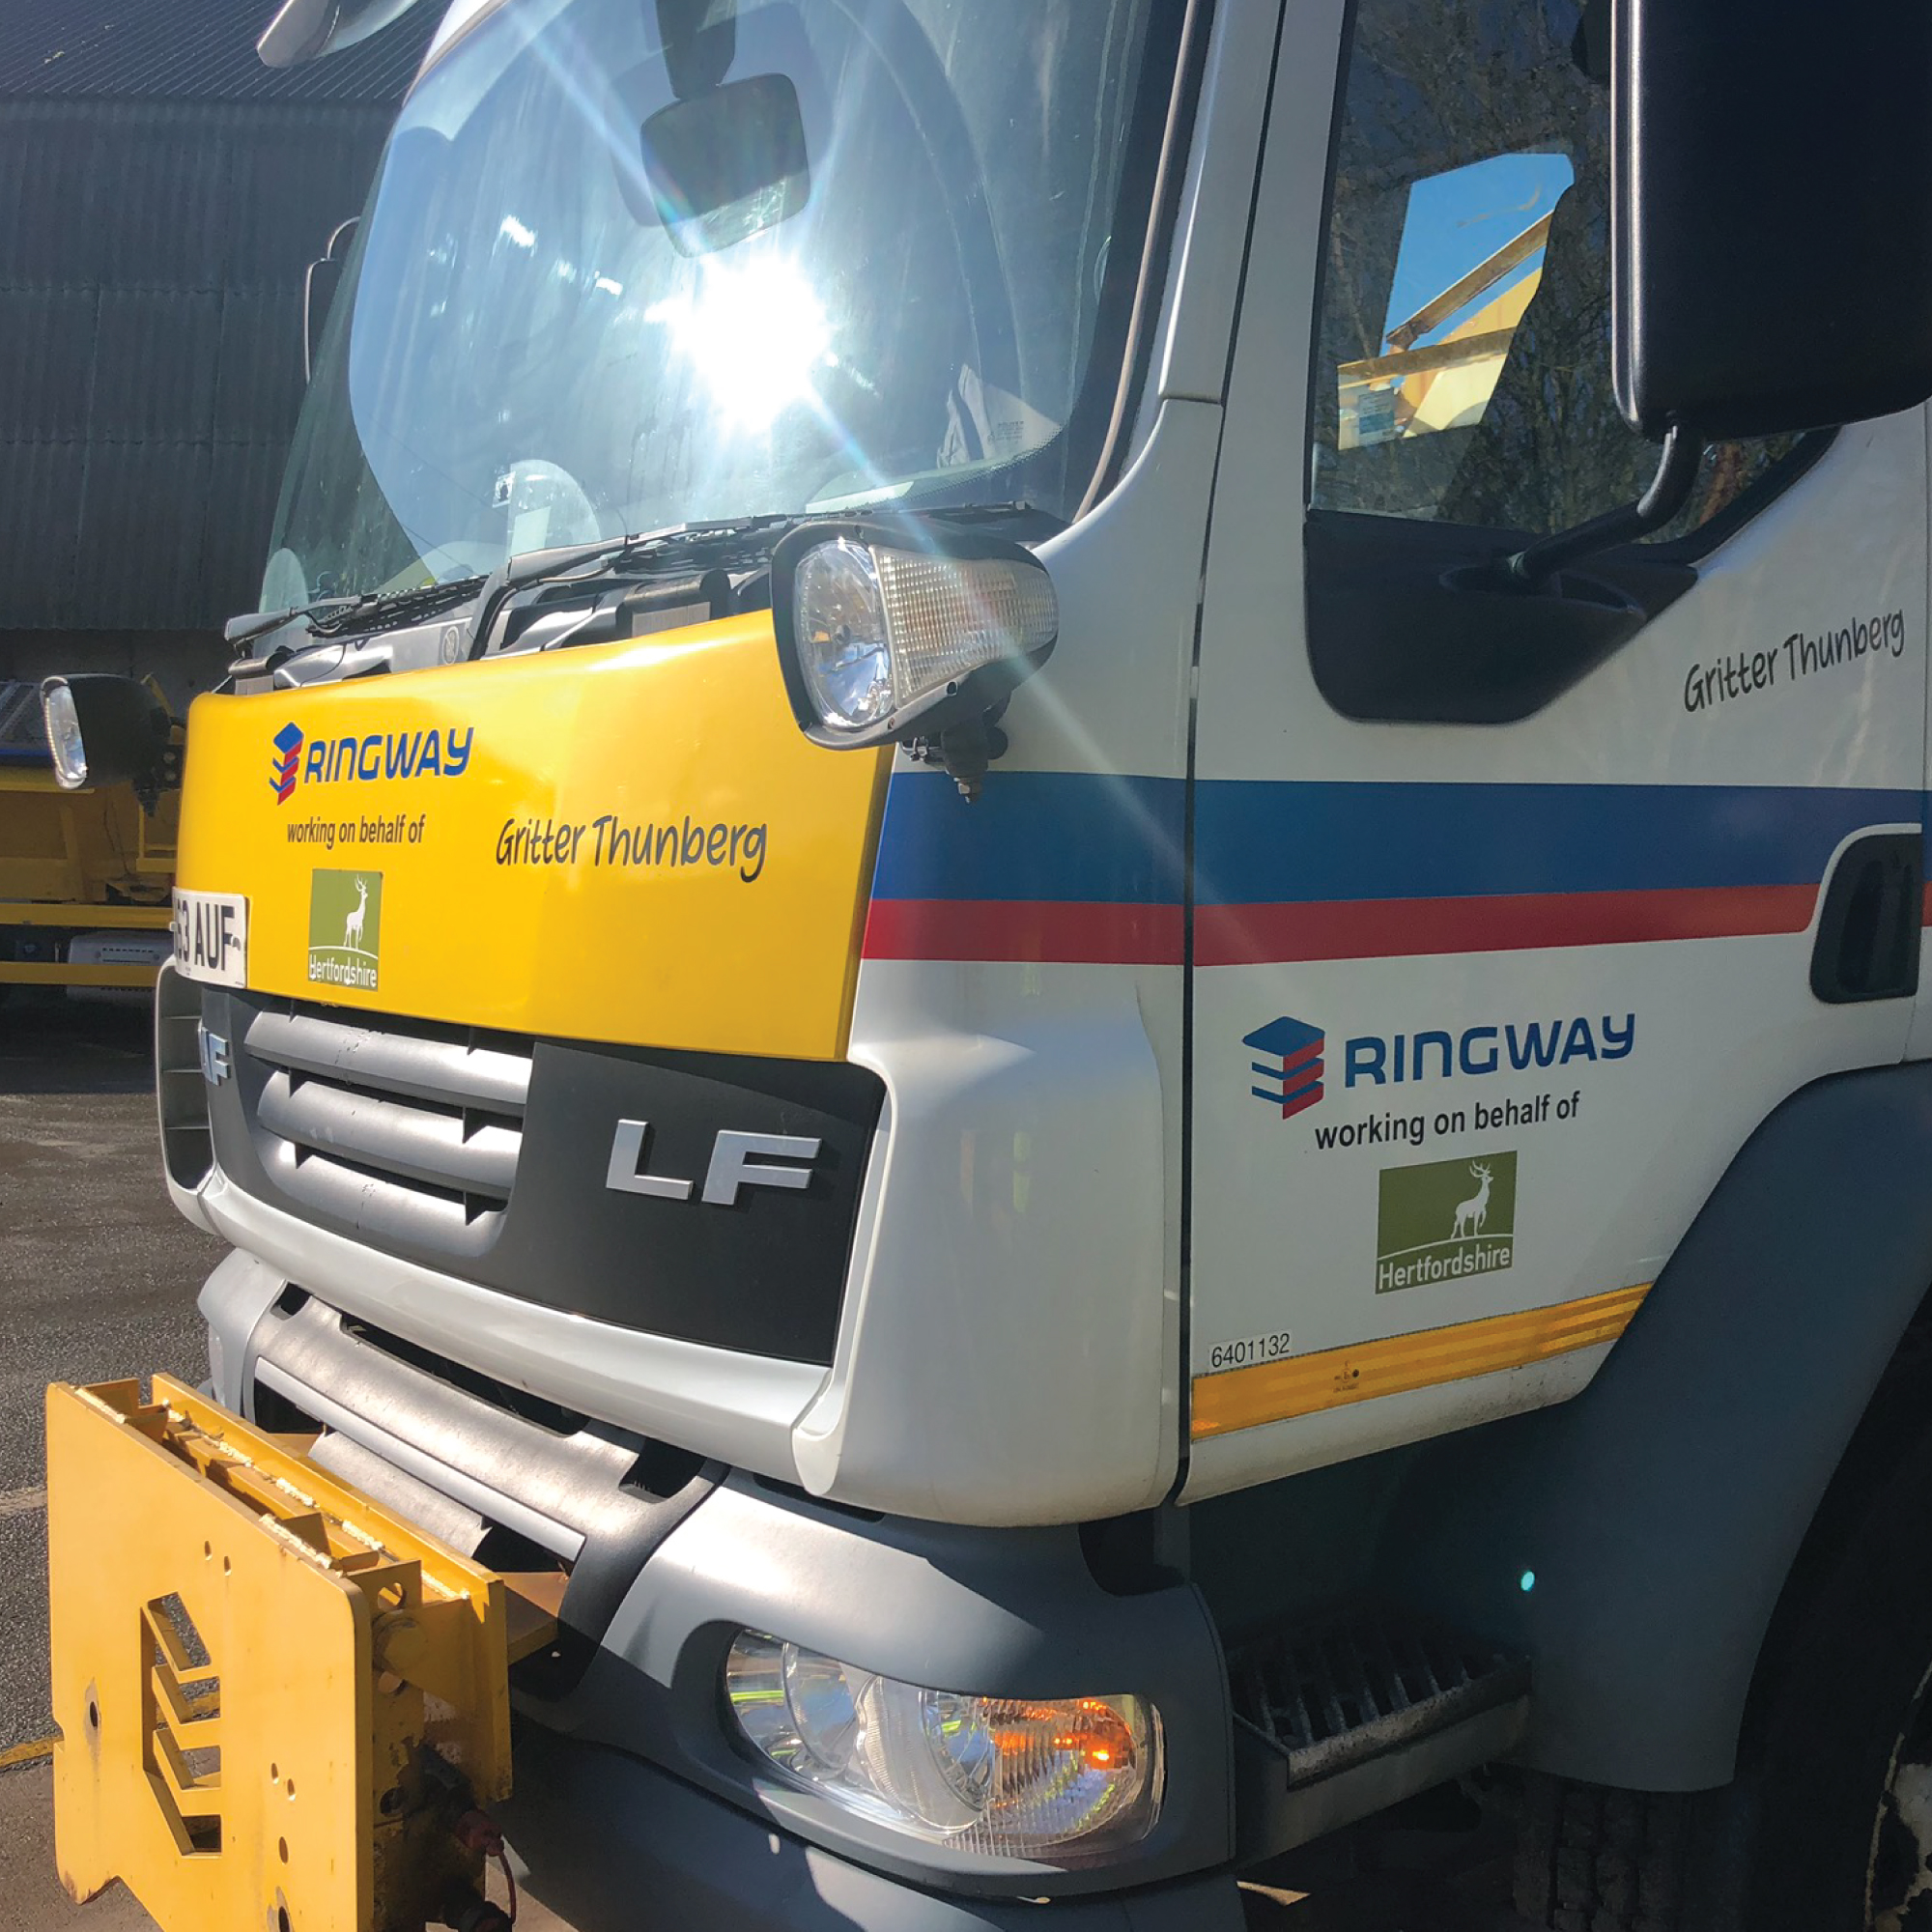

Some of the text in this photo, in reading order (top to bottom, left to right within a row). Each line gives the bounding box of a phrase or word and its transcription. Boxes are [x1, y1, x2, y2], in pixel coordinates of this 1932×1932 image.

[1684, 609, 1905, 712] Gritter Thunberg
[303, 726, 474, 783] RINGWAY
[287, 813, 426, 851] working on behalf of
[496, 815, 767, 883] Gritter Thunberg
[194, 900, 235, 972] AUF
[309, 953, 378, 987] Hertfordshire
[1345, 1013, 1635, 1089] RINGWAY
[1315, 1090, 1581, 1151] working on behalf of
[606, 1119, 822, 1206] LF
[1378, 1244, 1511, 1291] Hertfordshire
[1210, 1332, 1291, 1369] 6401132
